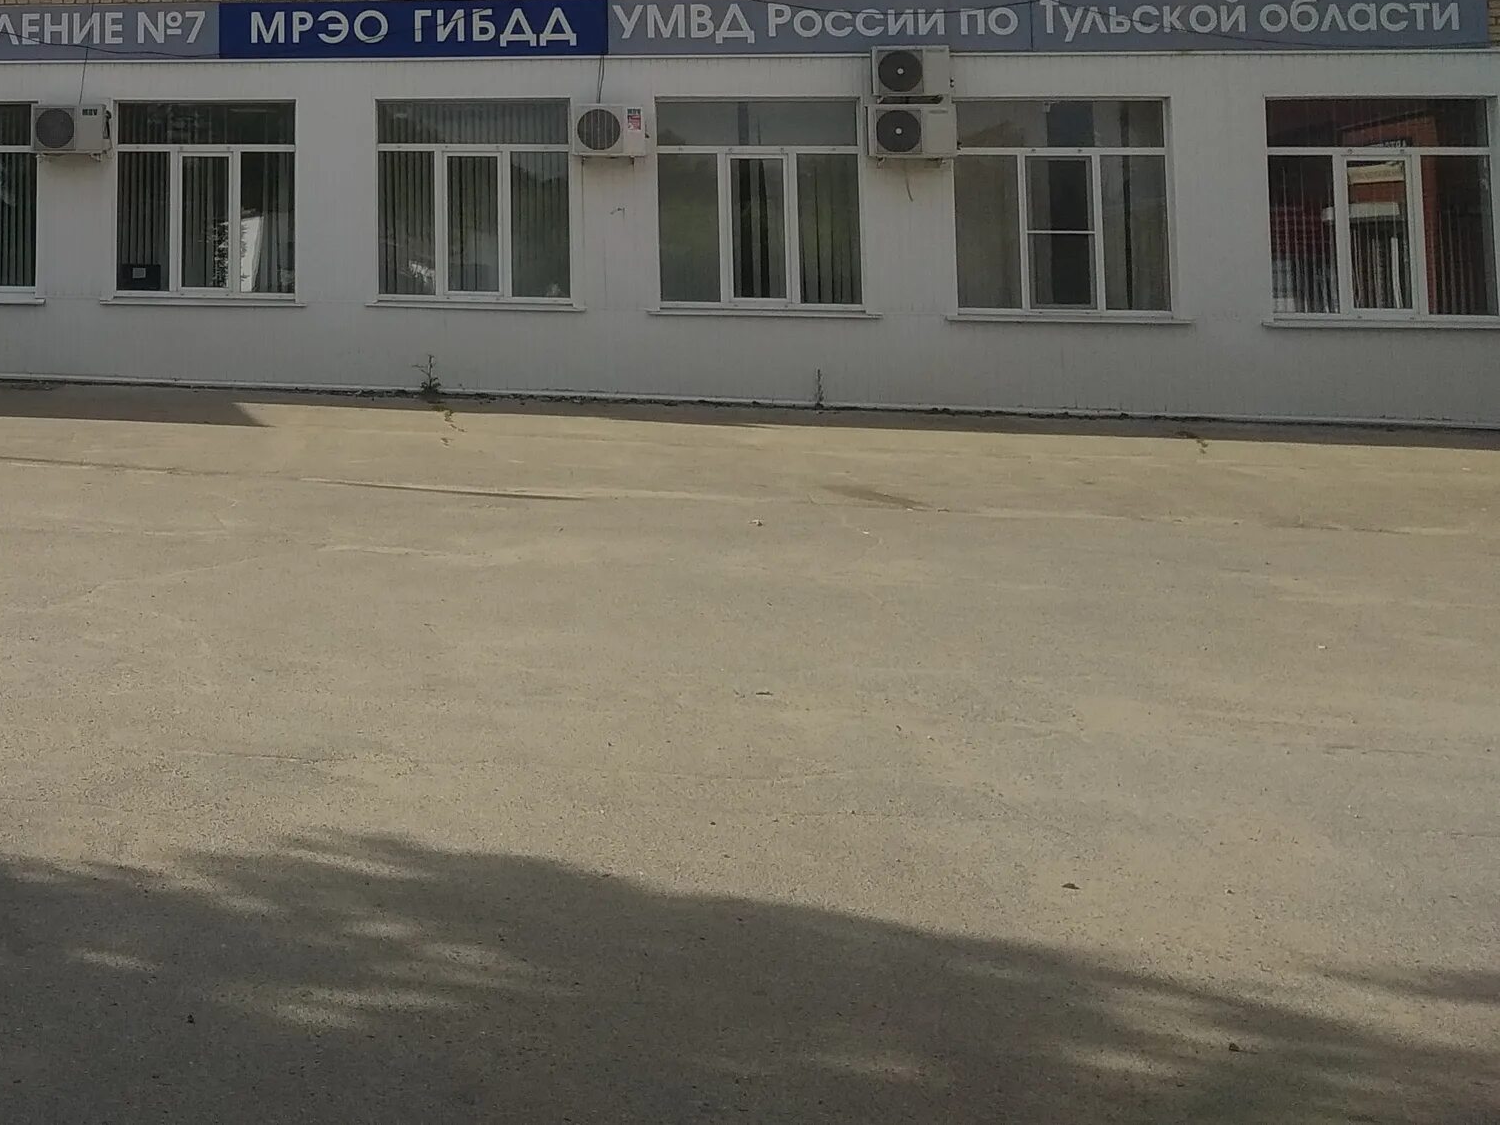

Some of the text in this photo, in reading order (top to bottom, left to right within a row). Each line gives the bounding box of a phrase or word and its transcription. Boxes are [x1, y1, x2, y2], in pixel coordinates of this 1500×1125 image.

[137, 10, 207, 47] №7
[250, 8, 389, 44] МРЭО
[414, 6, 578, 47] ГИБДД
[612, 3, 756, 45] УМВД
[767, 2, 948, 38] России
[959, 7, 1020, 36] по
